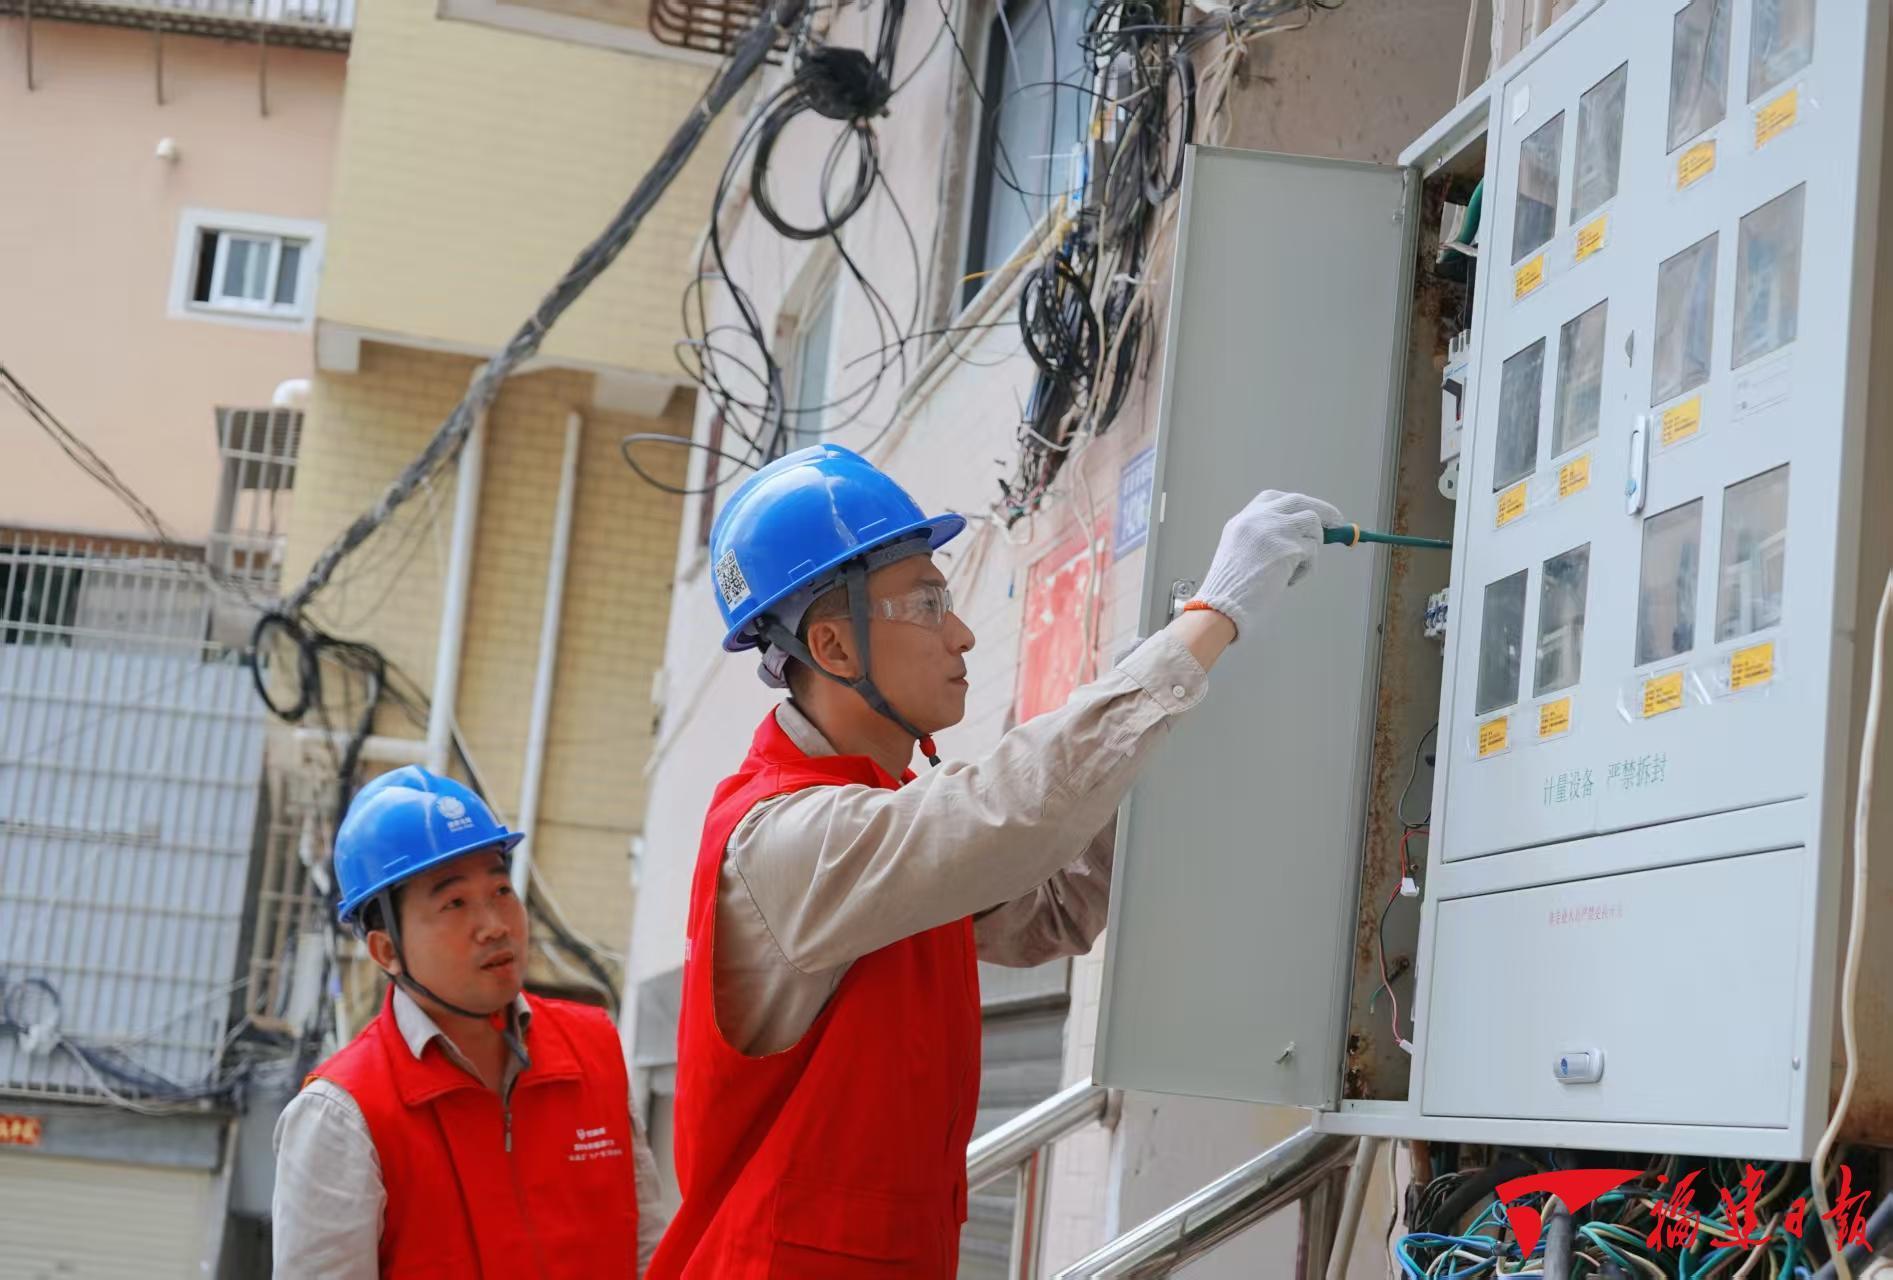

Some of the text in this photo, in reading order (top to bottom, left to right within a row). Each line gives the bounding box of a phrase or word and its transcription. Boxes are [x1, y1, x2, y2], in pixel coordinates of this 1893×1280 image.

[1543, 752, 1666, 808] 计量设备 严禁拆封
